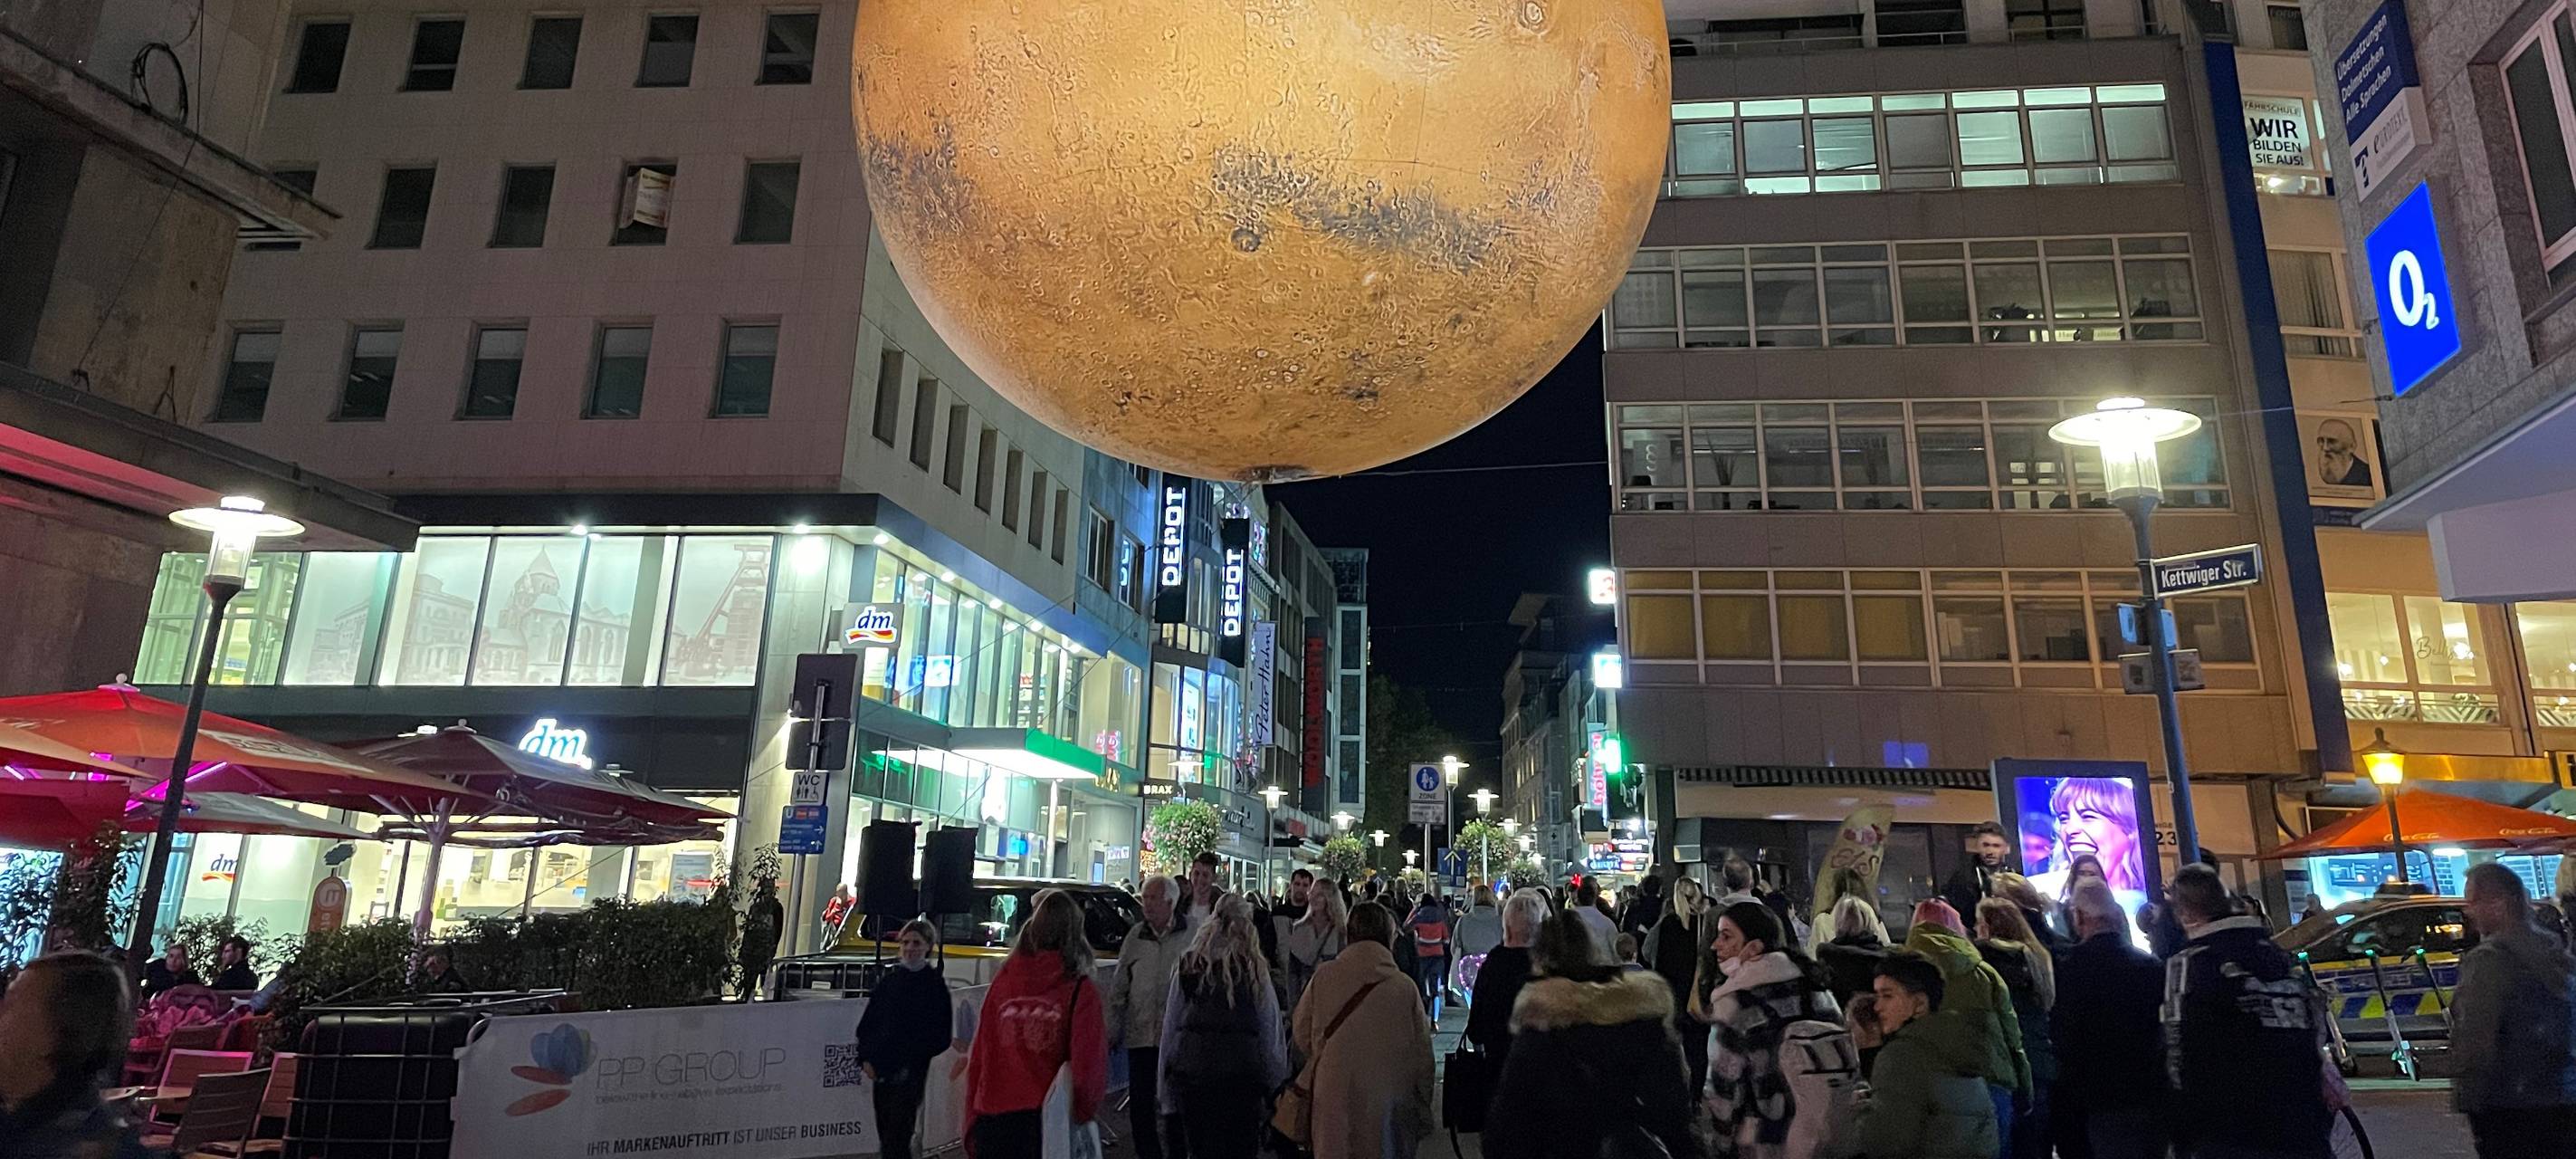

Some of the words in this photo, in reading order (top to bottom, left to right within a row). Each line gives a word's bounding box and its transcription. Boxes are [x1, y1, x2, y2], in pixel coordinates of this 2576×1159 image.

[2341, 46, 2384, 102] Dolmetschen
[2346, 104, 2360, 124] Alle
[2360, 65, 2391, 108] Sprachen
[2250, 117, 2299, 139] WIR
[2253, 139, 2302, 153] BILDEN
[2256, 153, 2274, 164] SIE
[2276, 154, 2304, 166] AUS!
[1162, 486, 1186, 586] DEPOT
[2161, 565, 2220, 589] Kettwiger
[2223, 560, 2247, 579] Str.
[1224, 549, 1245, 636] DEPOT
[858, 609, 891, 629] dm
[1257, 628, 1272, 685] Hahn
[1255, 681, 1269, 740] Peter
[523, 722, 585, 764] dm
[797, 774, 820, 786] WC
[1143, 784, 1173, 795] BRAX
[210, 853, 238, 872] dm
[597, 1057, 645, 1087] PP
[655, 1048, 786, 1085] GROUP
[587, 1141, 609, 1156] IHR
[613, 1131, 730, 1154] MARKENAUFTRITT
[733, 1128, 753, 1144] IST
[755, 1125, 797, 1142] UNSER
[800, 1121, 862, 1138] BUSINESS
